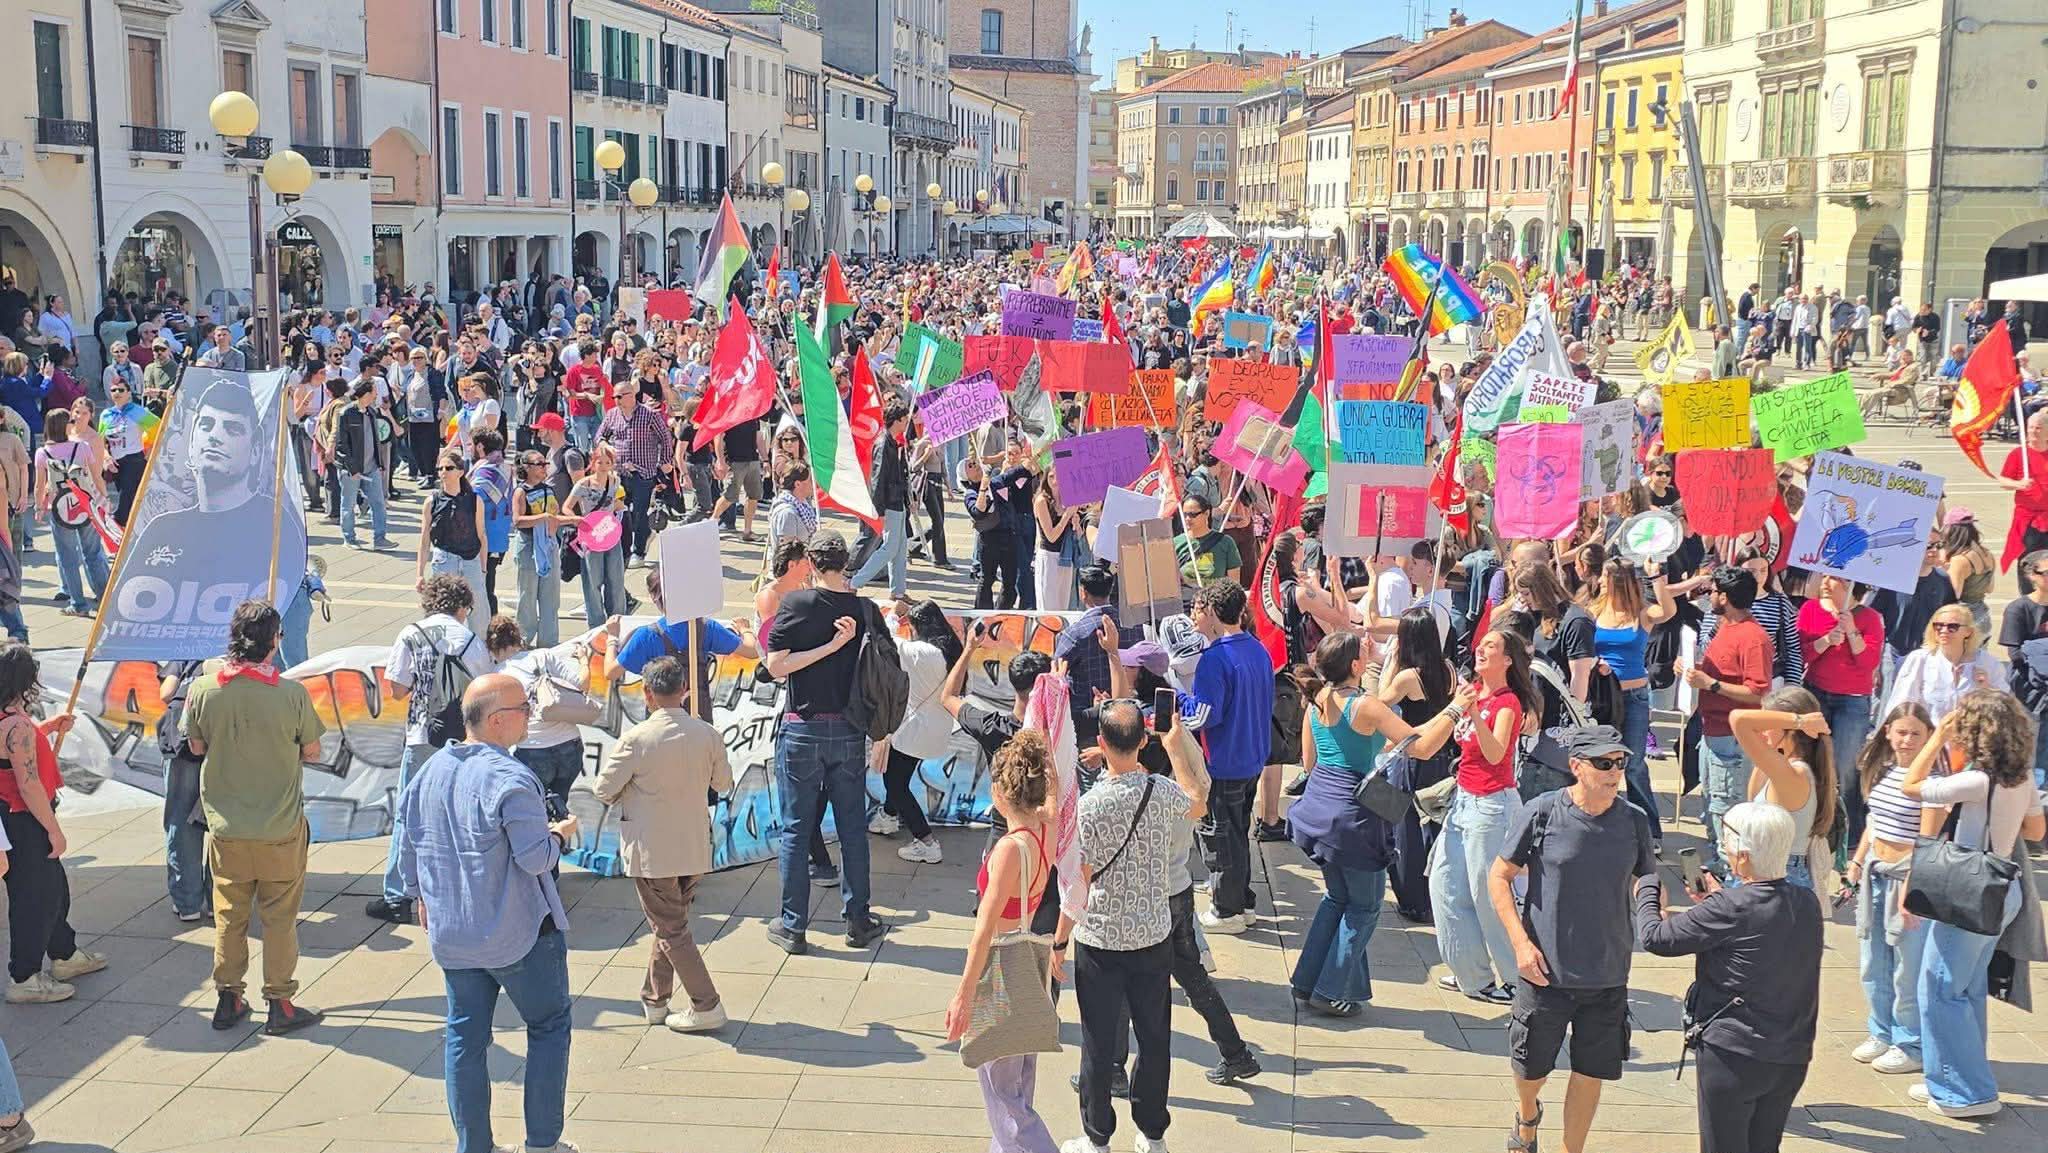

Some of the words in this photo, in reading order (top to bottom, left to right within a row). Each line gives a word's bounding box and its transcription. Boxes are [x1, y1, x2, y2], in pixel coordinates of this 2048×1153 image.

[1006, 292, 1072, 320] REPRESSIONE
[1531, 383, 1585, 402] SOLTANTO
[1534, 374, 1586, 394] SAPETE
[927, 393, 971, 420] NEMICO
[931, 417, 952, 433] CHI
[952, 395, 1002, 425] FINANZIA
[1383, 404, 1424, 430] GUERRA
[1753, 396, 1771, 416] LA
[1783, 403, 1802, 422] LA
[1804, 398, 1826, 416] FA
[952, 408, 1002, 435] GUERRA
[1665, 413, 1749, 448] NIENTE
[1837, 462, 1884, 488] VOSTRE
